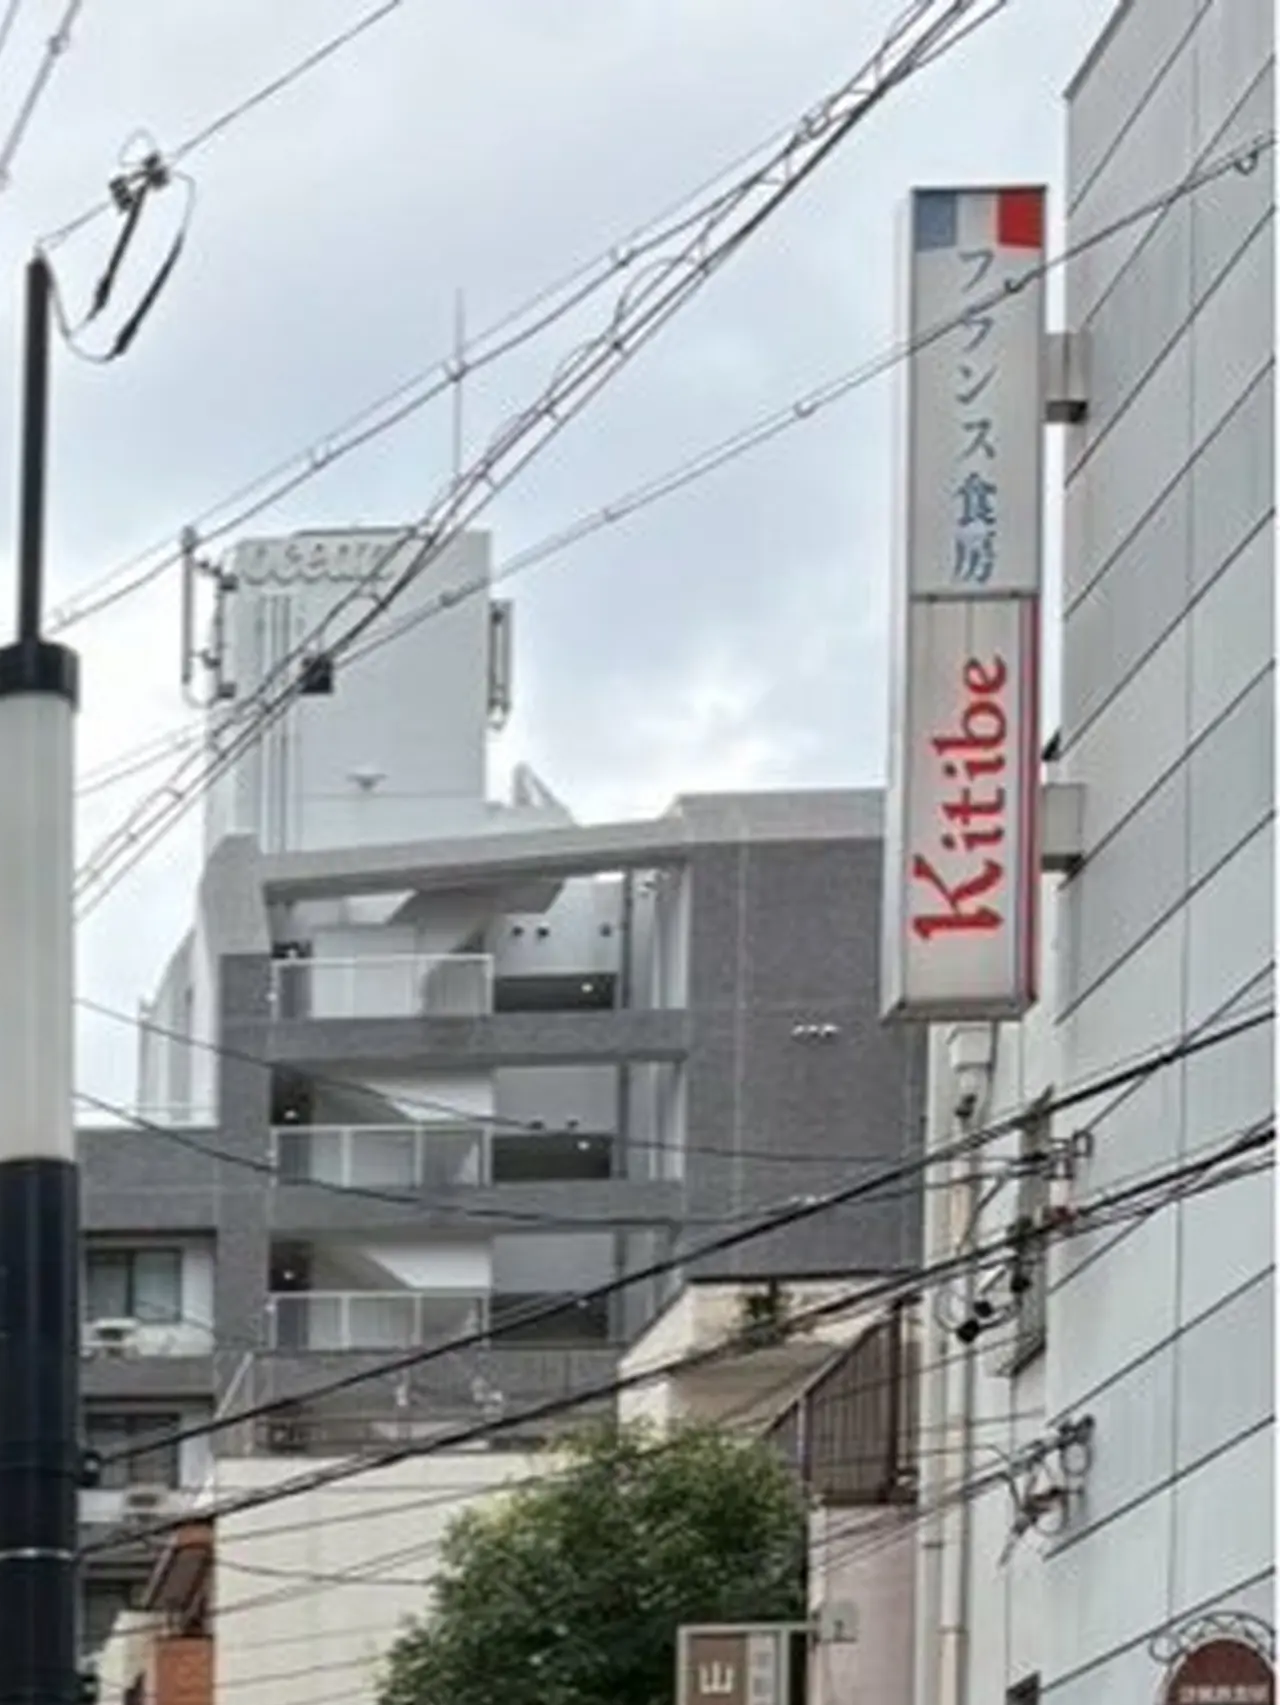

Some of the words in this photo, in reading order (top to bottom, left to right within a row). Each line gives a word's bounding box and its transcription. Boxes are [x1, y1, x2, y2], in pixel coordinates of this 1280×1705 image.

[954, 249, 999, 584] フランス食房
[913, 654, 1009, 942] Kitibe
